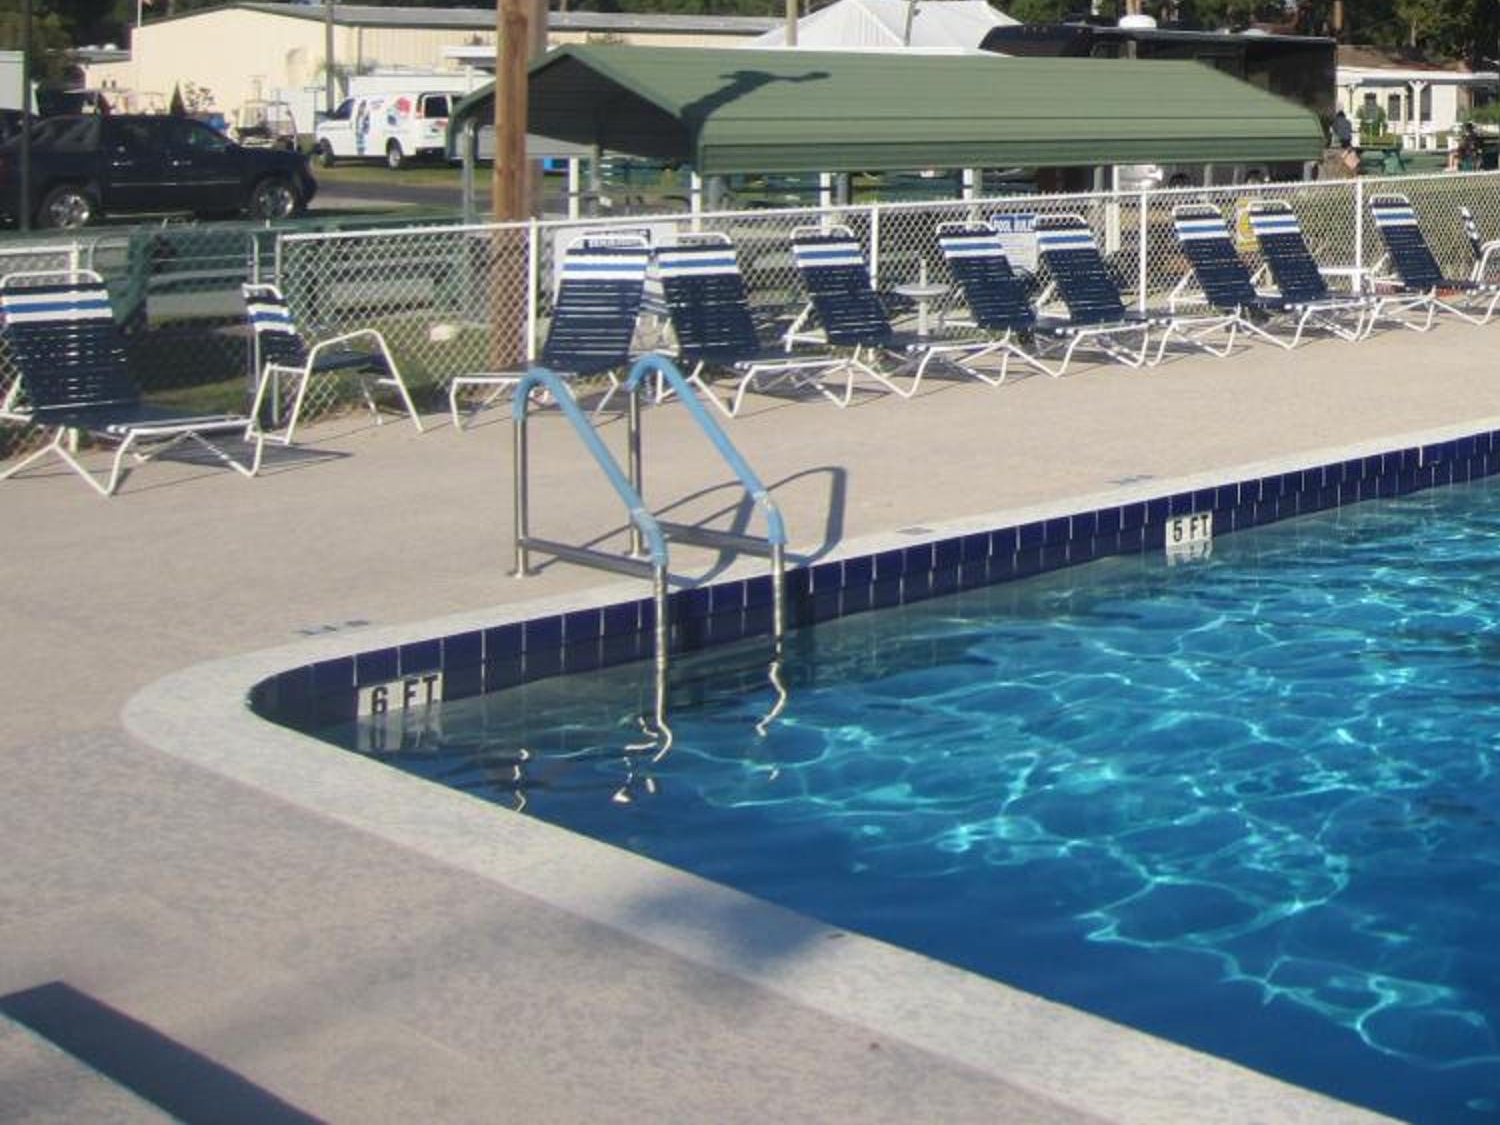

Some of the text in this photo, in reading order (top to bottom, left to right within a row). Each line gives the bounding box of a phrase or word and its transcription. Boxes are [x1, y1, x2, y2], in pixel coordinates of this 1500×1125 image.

[1173, 515, 1209, 542] 5 FT
[371, 675, 440, 715] 6 FT
